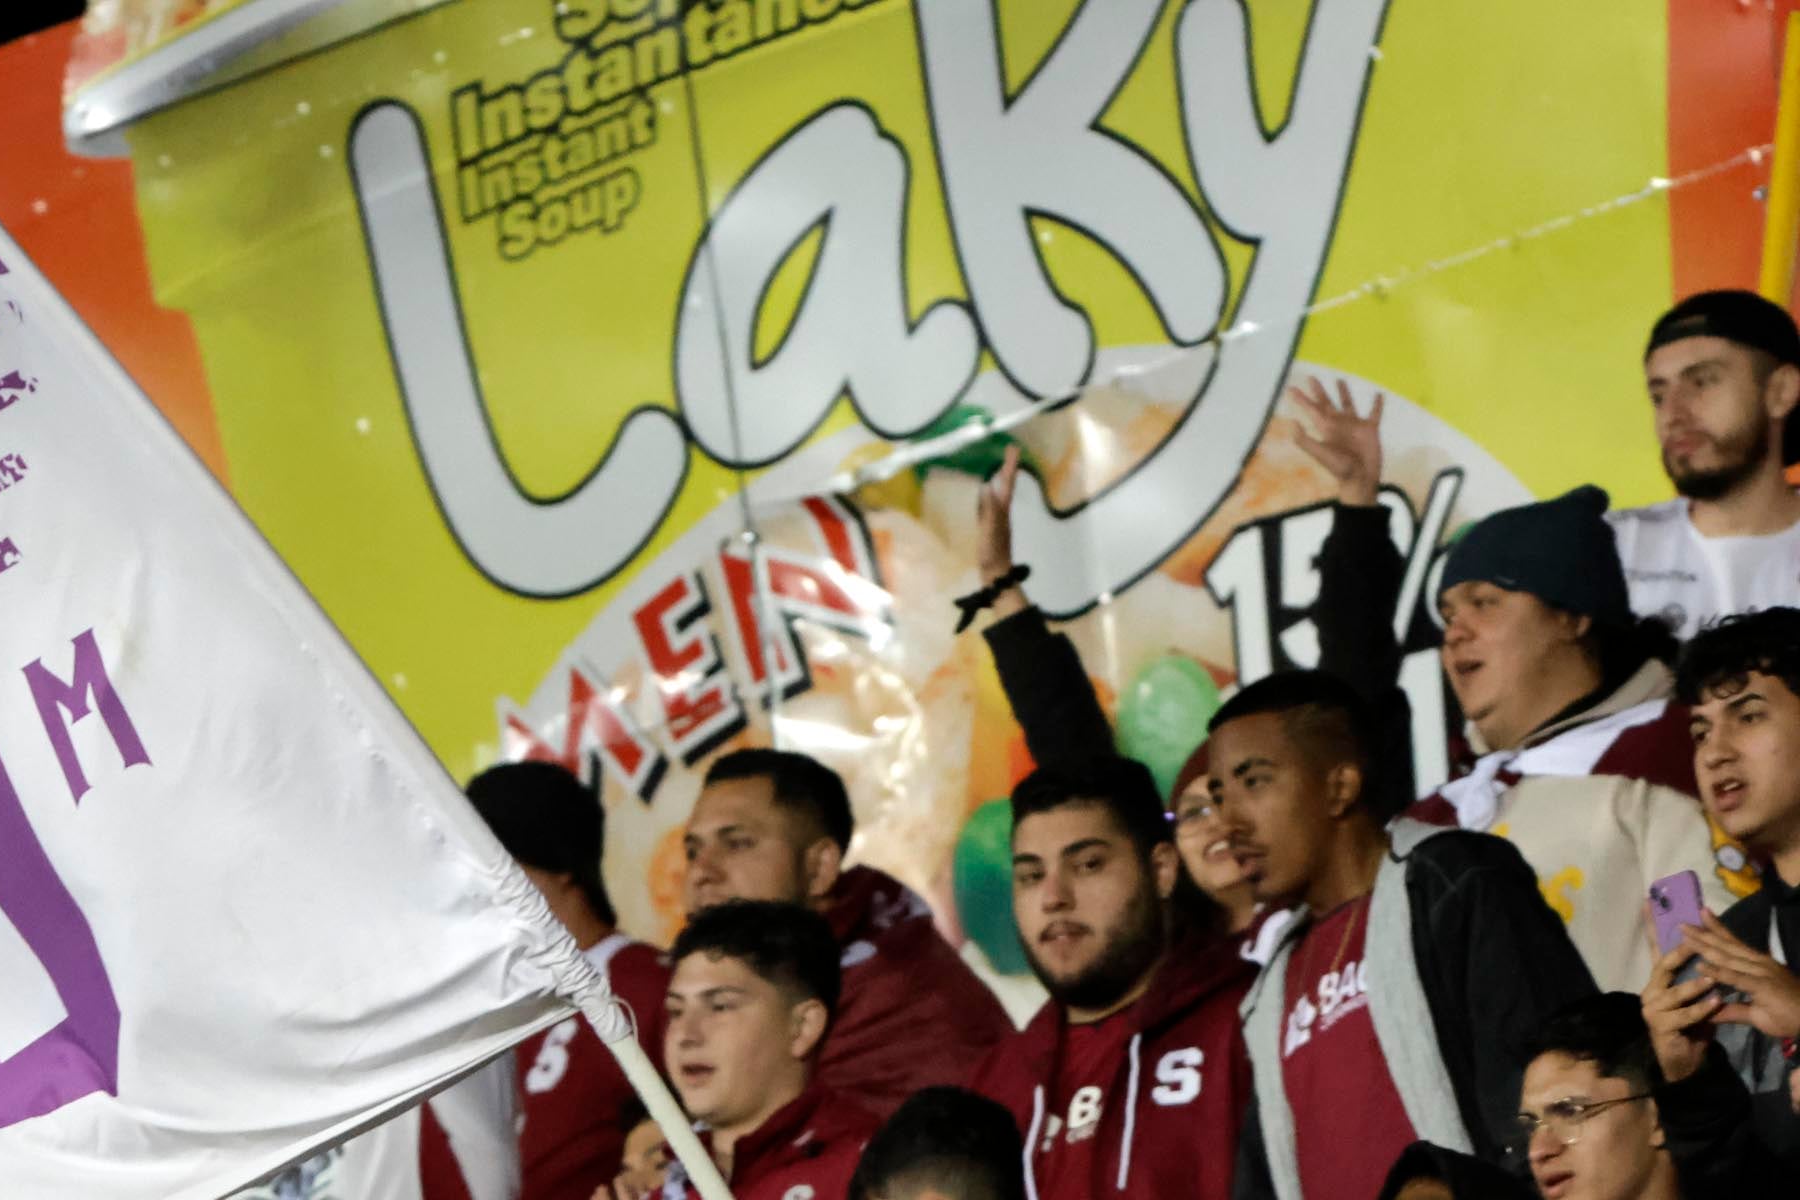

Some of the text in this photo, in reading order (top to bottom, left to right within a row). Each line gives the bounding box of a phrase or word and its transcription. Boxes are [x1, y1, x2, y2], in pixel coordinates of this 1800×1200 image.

[458, 98, 658, 222] Instant
[497, 166, 641, 262] Soup
[22, 628, 153, 807] M
[1151, 1046, 1204, 1106] S
